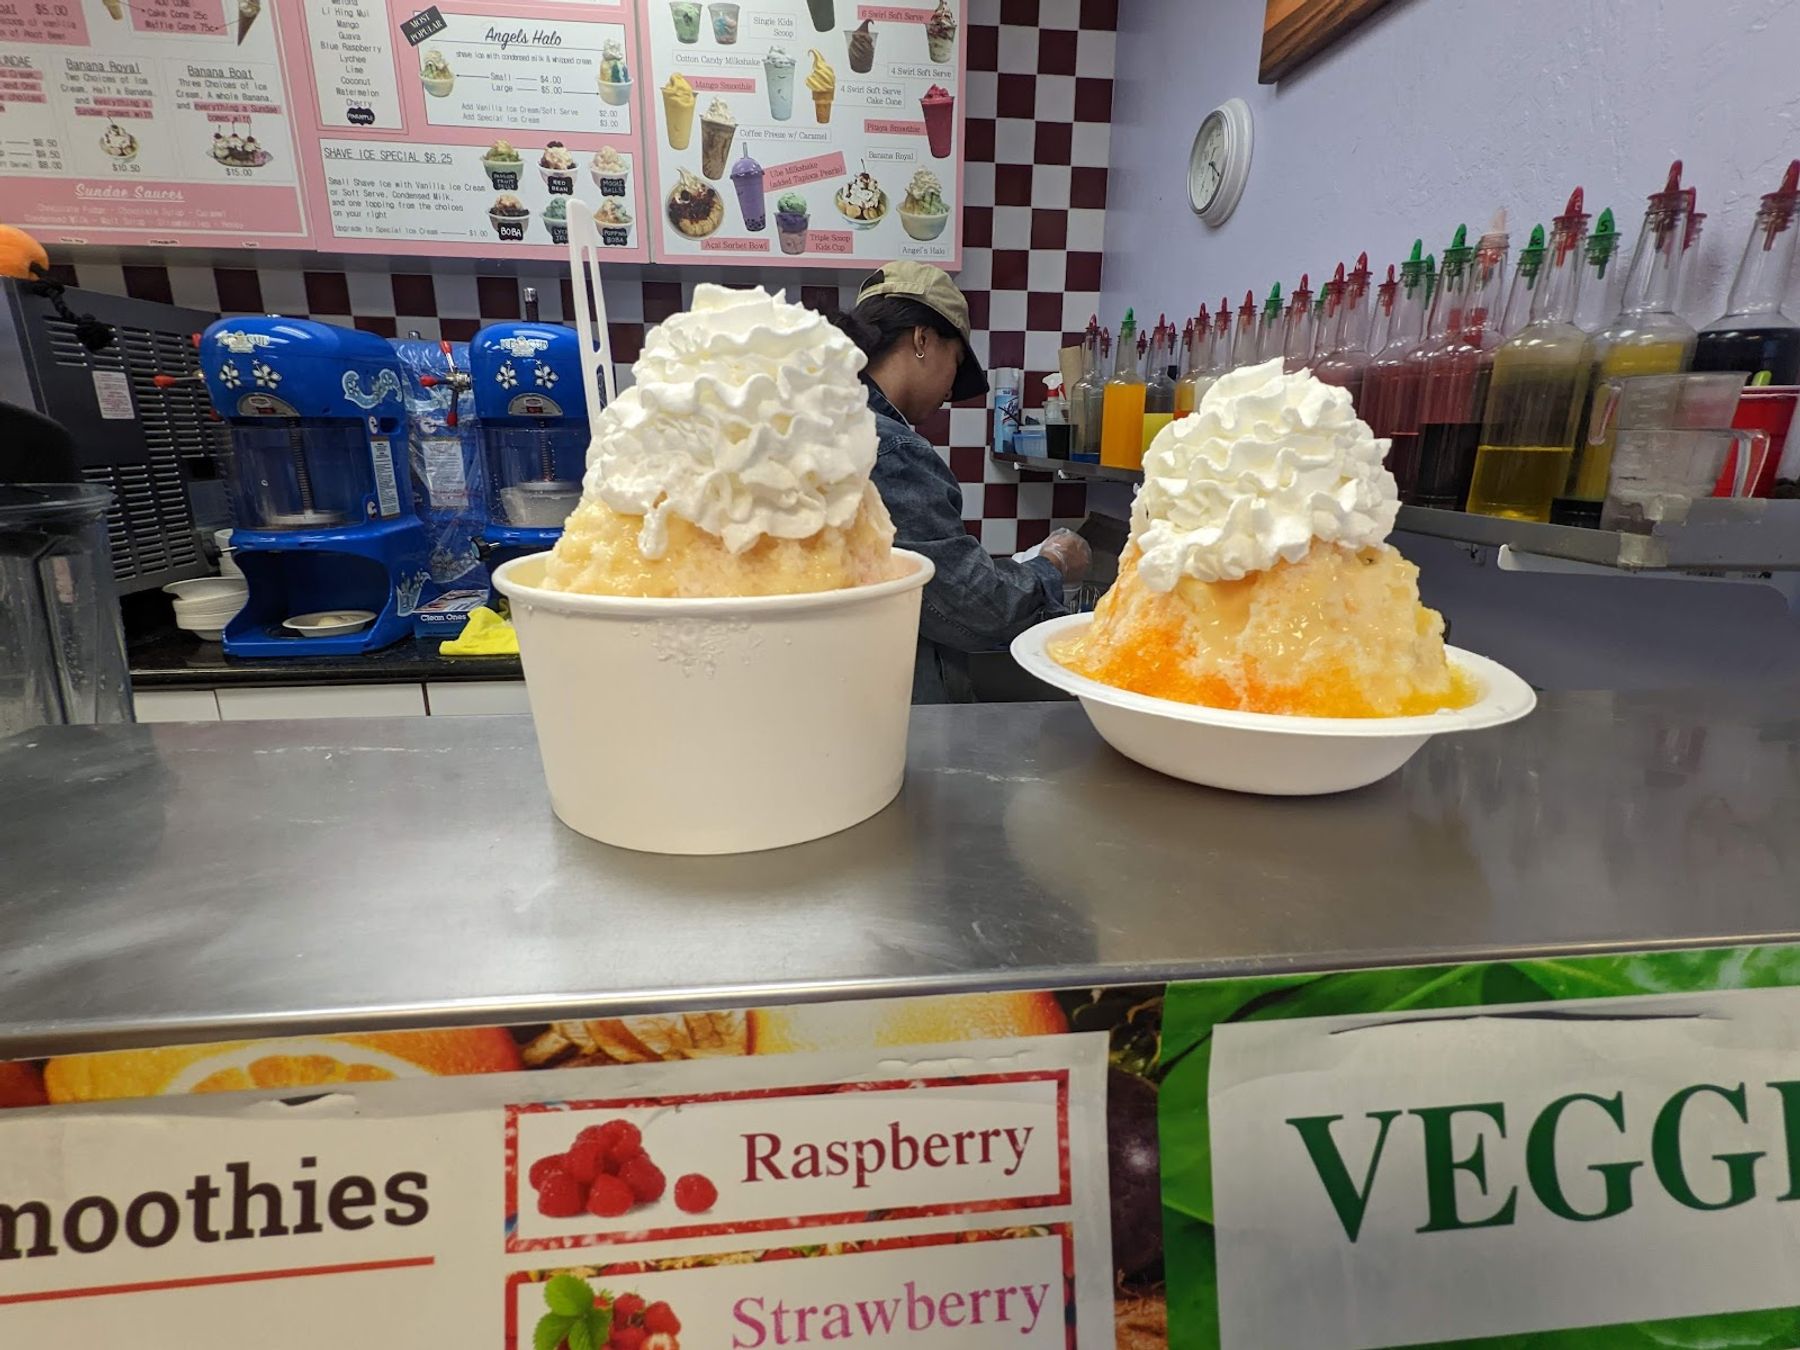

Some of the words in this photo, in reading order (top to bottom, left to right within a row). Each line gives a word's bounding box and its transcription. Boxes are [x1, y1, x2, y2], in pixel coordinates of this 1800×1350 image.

[34, 3, 68, 16] $5.00
[335, 7, 354, 18] Hing
[409, 11, 431, 29] MOST
[753, 16, 775, 26] Single
[777, 17, 793, 26] Kids
[868, 10, 887, 18] Swirl
[888, 12, 902, 20] Soft
[904, 13, 924, 21] Serve
[337, 19, 360, 30] Mango
[338, 31, 361, 40] Guava
[410, 19, 443, 44] POPULAR
[773, 29, 794, 38] Scoop
[485, 26, 528, 50] Angels
[532, 29, 562, 46] Halo
[320, 41, 339, 50] Blue
[342, 42, 382, 53] Raspberry
[340, 54, 366, 64] Lychee
[502, 54, 530, 62] condensed
[552, 57, 574, 65] whipped
[675, 55, 699, 64] Cotton
[701, 56, 723, 66] Candy
[725, 57, 760, 66] Milkshake
[65, 58, 105, 71] Banana
[110, 61, 141, 73] Royal
[346, 65, 364, 74] Lime
[65, 72, 80, 81] Two
[83, 73, 116, 83] Choices
[187, 65, 225, 78] Banana
[229, 67, 254, 80] Boat
[897, 67, 916, 76] Swirl
[917, 68, 931, 76] Soft
[932, 69, 952, 78] Serve
[340, 76, 371, 86] Coconut
[490, 72, 511, 81] Small
[540, 75, 562, 85] $4.00
[178, 78, 201, 88] Three
[205, 80, 237, 90] Choices
[254, 82, 268, 91] Ice
[491, 84, 513, 93] Large
[541, 86, 563, 95] $5.00
[695, 80, 719, 90] Mango
[720, 82, 753, 91] Smoothie
[866, 86, 880, 94] Soft
[216, 91, 239, 101] whole
[335, 87, 379, 97] Watermelon
[346, 98, 372, 108] Cherry
[866, 97, 883, 105] Cake
[176, 102, 191, 110] and
[194, 103, 240, 113] everything
[251, 104, 278, 114] Sundae
[462, 103, 474, 111] Add
[476, 103, 502, 112] Vanilla
[559, 108, 579, 116] Serve
[599, 110, 618, 118] $2.00
[463, 113, 475, 121] Add
[477, 114, 503, 124] Special
[520, 116, 540, 124] Cream
[600, 120, 619, 128] $3.00
[739, 128, 762, 138] Coffee
[764, 129, 786, 138] Freeze
[788, 131, 798, 140] w/
[799, 131, 827, 140] Caramel
[890, 124, 920, 133] Smoothie
[324, 148, 353, 160] SHAVE
[359, 149, 376, 161] ICE
[380, 151, 420, 162] SPECIAL
[424, 152, 453, 164] $6.25
[868, 151, 893, 160] Banana
[895, 152, 914, 161] Royal
[112, 163, 141, 173] $10.50
[226, 167, 253, 177] $15.00
[785, 162, 818, 175] Milkshake
[792, 172, 818, 184] Tapioca
[328, 177, 349, 186] Small
[353, 178, 375, 188] Shave
[395, 181, 413, 189] with
[416, 181, 445, 191] Vanilla
[464, 183, 486, 192] Cream
[75, 183, 129, 199] Sundae
[134, 185, 184, 200] Sauces
[343, 188, 359, 197] Soft
[392, 191, 430, 200] Condensed
[331, 199, 345, 207] and
[349, 200, 362, 208] one
[365, 201, 395, 210] topping
[418, 202, 431, 211] the
[435, 203, 464, 212] choices
[345, 211, 362, 219] your
[366, 209, 387, 219] right
[375, 226, 401, 236] Special
[419, 228, 439, 236] Cream
[469, 231, 489, 239] $1.00
[500, 226, 522, 238] BOBA
[810, 233, 829, 243] Triple
[831, 234, 851, 244] Scoop
[723, 240, 747, 249] Sorbet
[749, 241, 767, 250] Bowl
[815, 243, 830, 251] Kids
[832, 243, 846, 252] Cup
[931, 246, 946, 255] Halo
[421, 614, 445, 622] Clean
[446, 613, 467, 621] Ones
[740, 1120, 1035, 1190] Raspberry
[731, 1280, 1051, 1350] Strawberry
